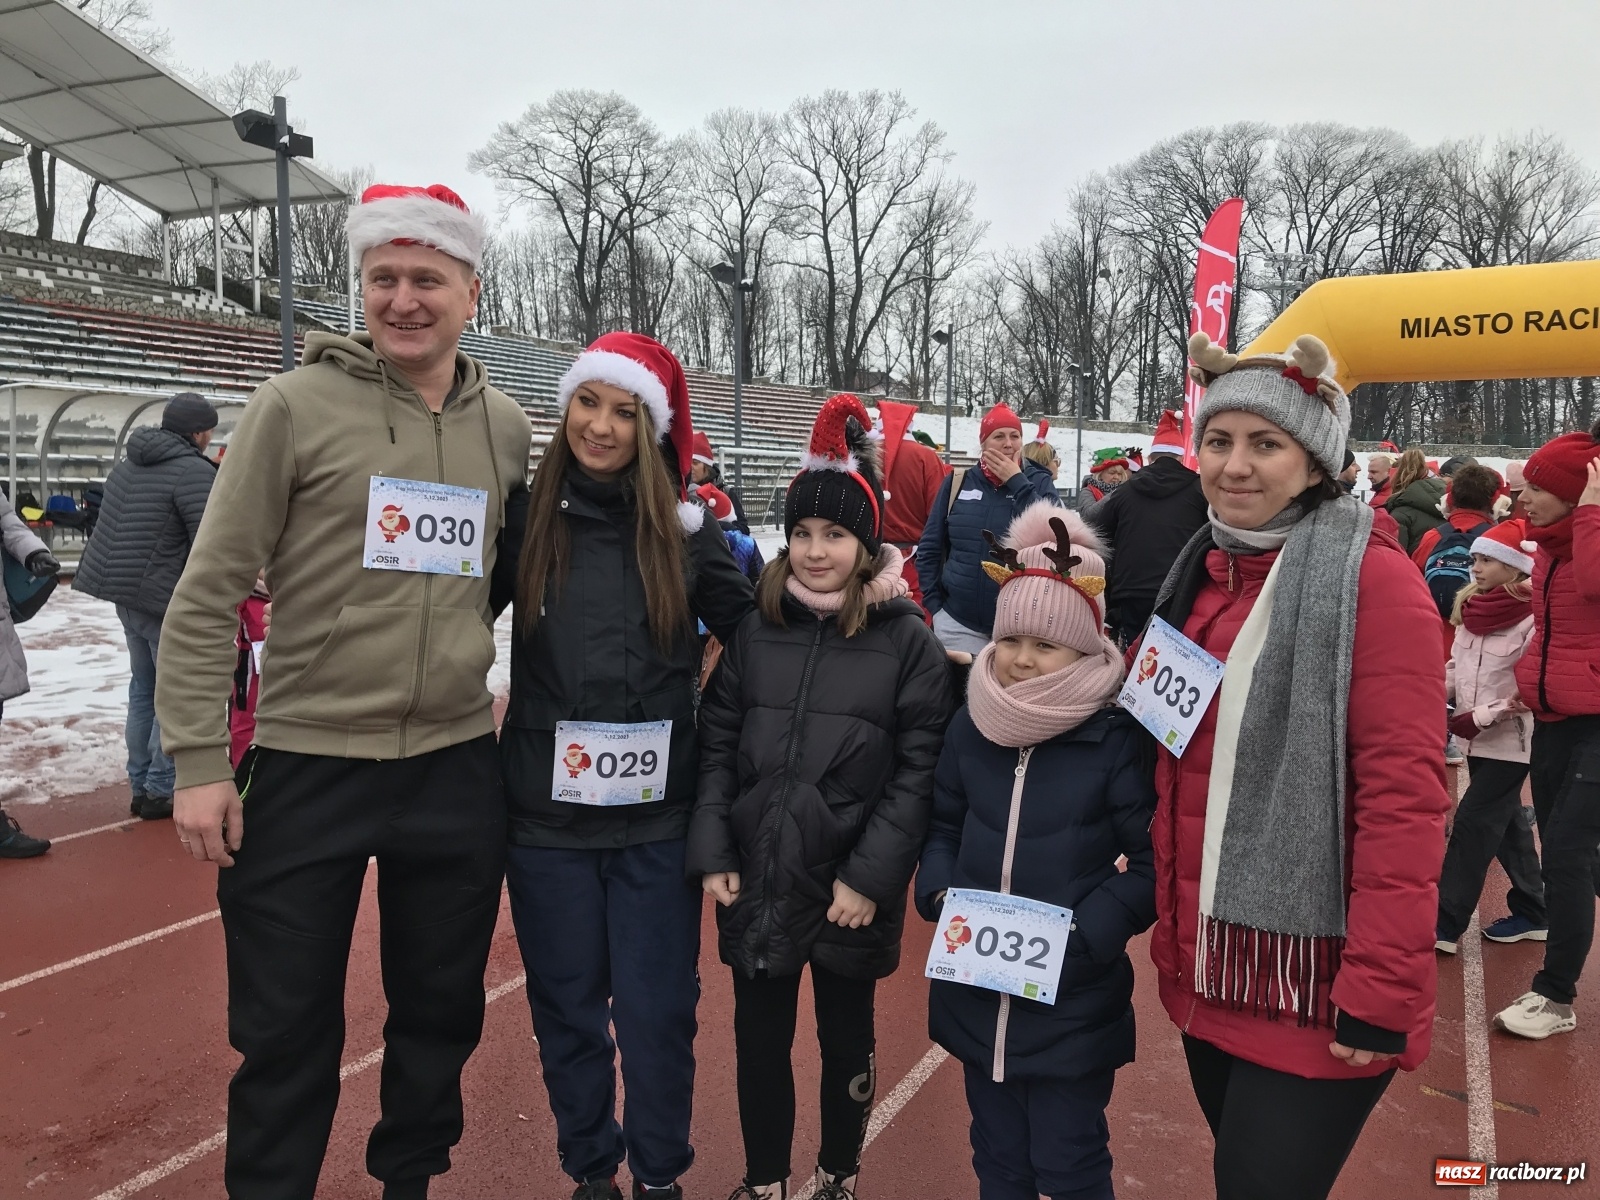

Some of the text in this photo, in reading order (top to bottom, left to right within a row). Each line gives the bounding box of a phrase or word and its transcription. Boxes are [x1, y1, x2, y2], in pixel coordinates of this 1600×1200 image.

[1400, 306, 1600, 339] MIASTO RACI
[415, 513, 475, 547] 030
[1153, 665, 1201, 718] 033
[595, 749, 658, 779] 029
[974, 925, 1051, 970] 032
